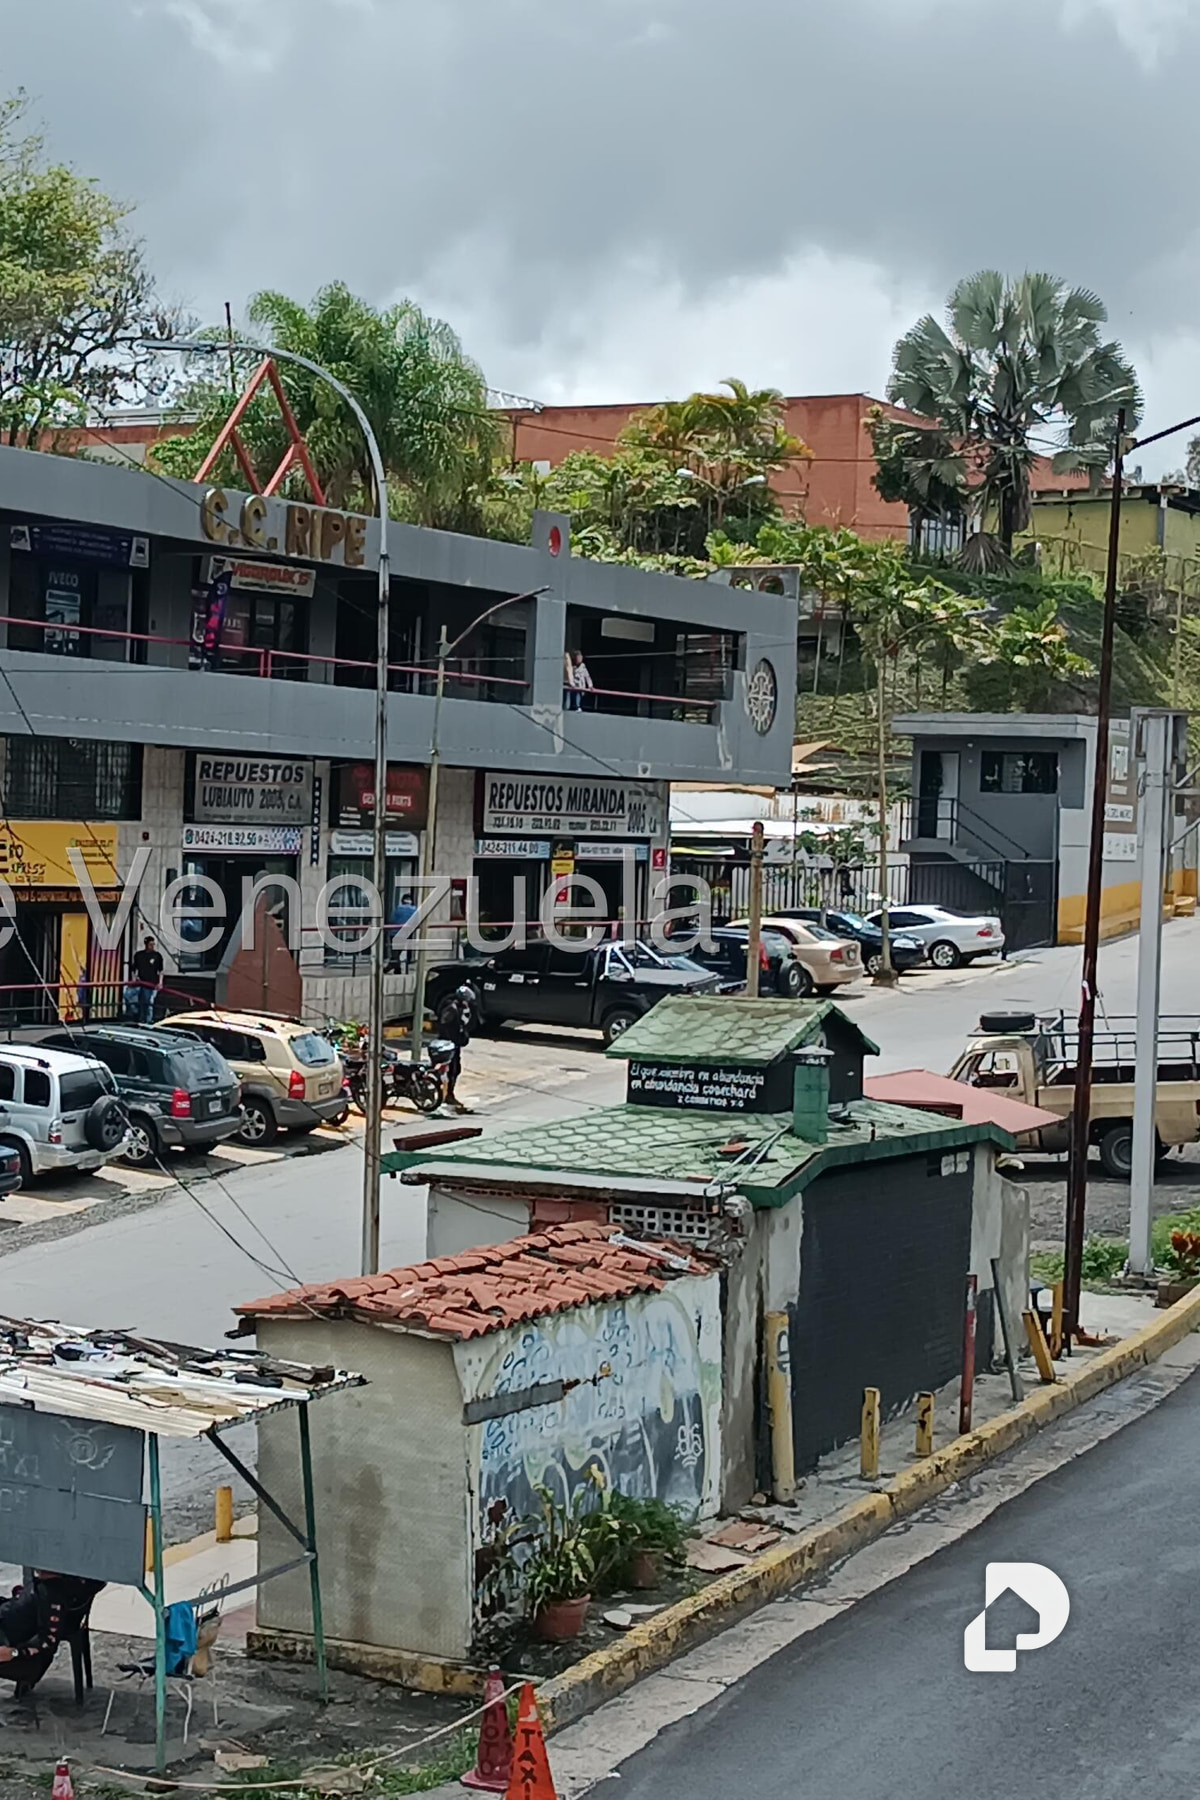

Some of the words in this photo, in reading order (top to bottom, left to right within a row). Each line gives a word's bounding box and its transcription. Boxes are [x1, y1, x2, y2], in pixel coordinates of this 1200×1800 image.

[285, 505, 367, 566] RIPE
[48, 571, 79, 588] IVECO
[200, 760, 305, 783] REPUESTOS
[489, 782, 563, 812] REPUESTOS
[566, 786, 626, 814] MIRANDA
[631, 1079, 642, 1090] en
[698, 1071, 710, 1081] en
[517, 1728, 538, 1800] TAXI
